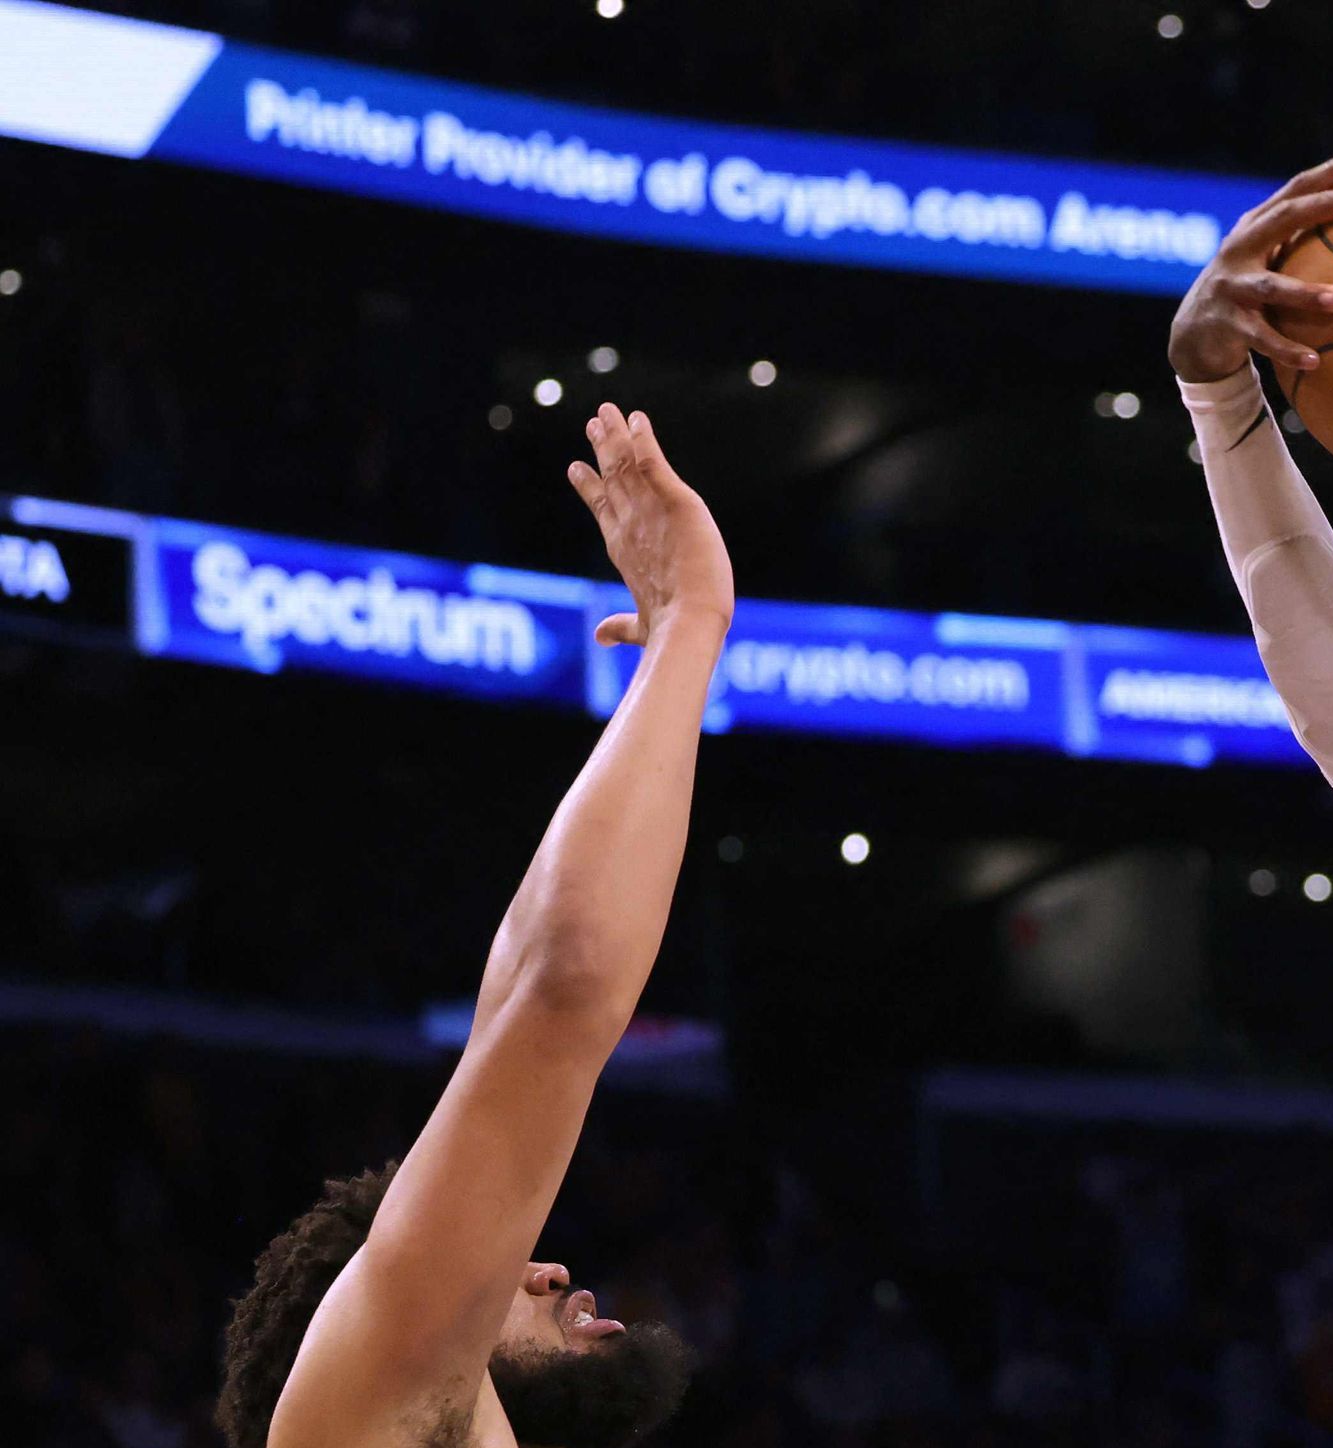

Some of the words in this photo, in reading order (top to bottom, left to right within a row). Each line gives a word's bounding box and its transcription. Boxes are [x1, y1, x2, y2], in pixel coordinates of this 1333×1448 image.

[245, 77, 420, 170] Printer
[421, 110, 643, 207] Provider
[643, 150, 709, 216] of
[709, 156, 1047, 251] Crypto.com
[1047, 190, 1221, 267] Arena
[193, 541, 537, 675] Spectrum
